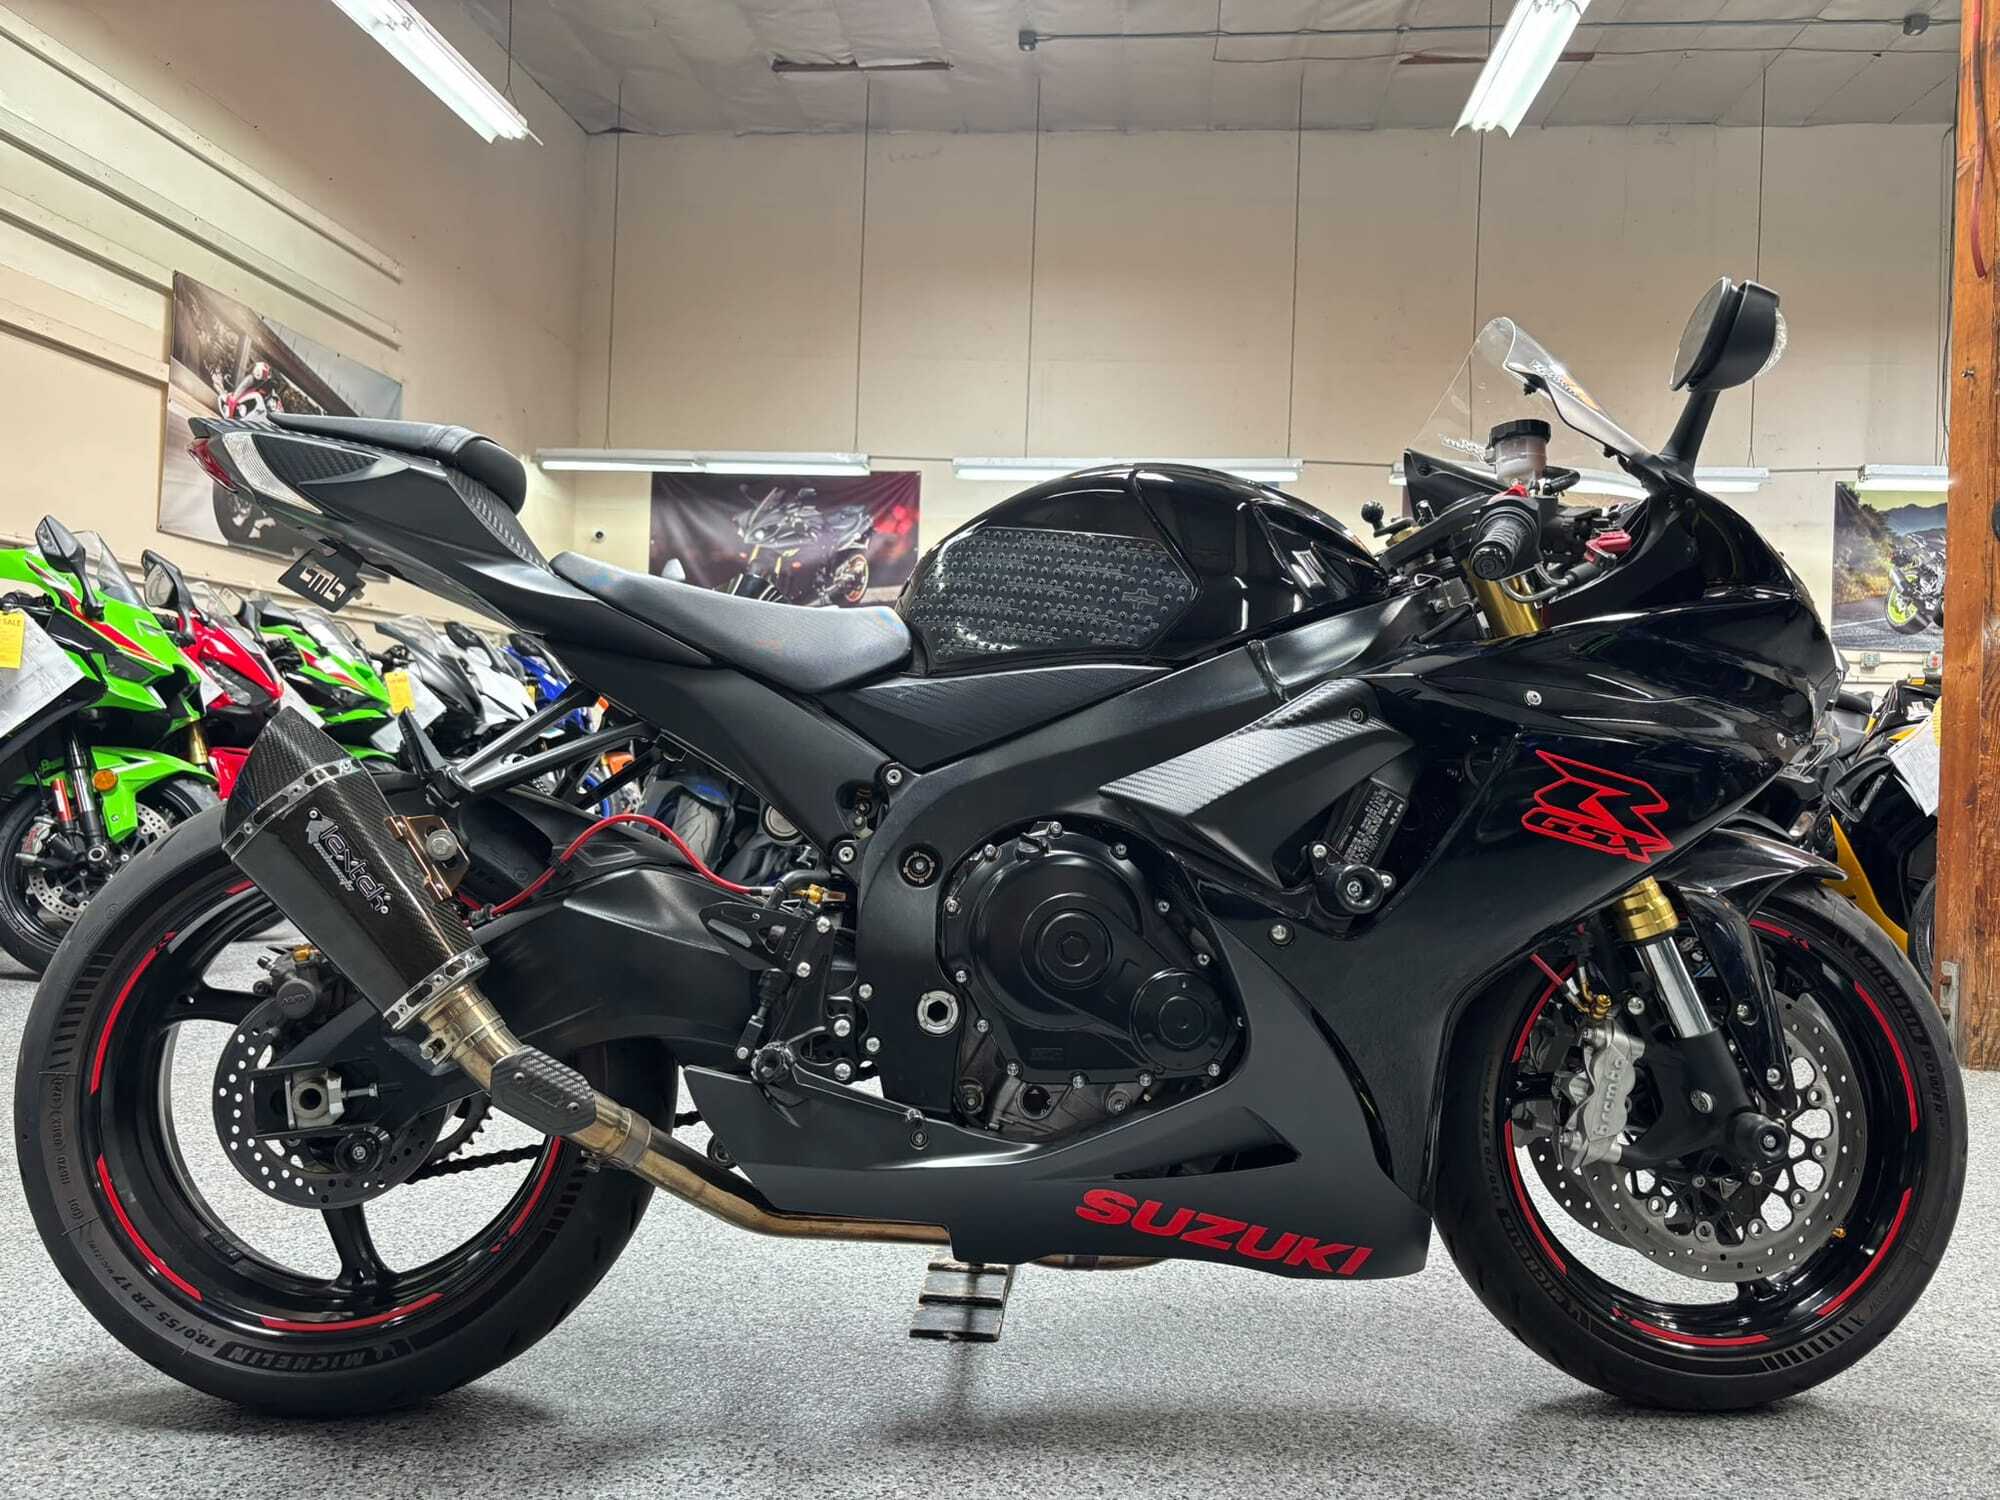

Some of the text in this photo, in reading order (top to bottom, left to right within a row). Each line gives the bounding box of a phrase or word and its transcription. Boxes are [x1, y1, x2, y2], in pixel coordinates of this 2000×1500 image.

[1592, 1057, 1625, 1137] brembo
[1075, 1188, 1374, 1276] SUZUKI
[112, 1275, 133, 1291] 17
[131, 1292, 156, 1311] ZR
[155, 1311, 217, 1348] 180/55
[228, 1349, 367, 1372] MICHELIN
